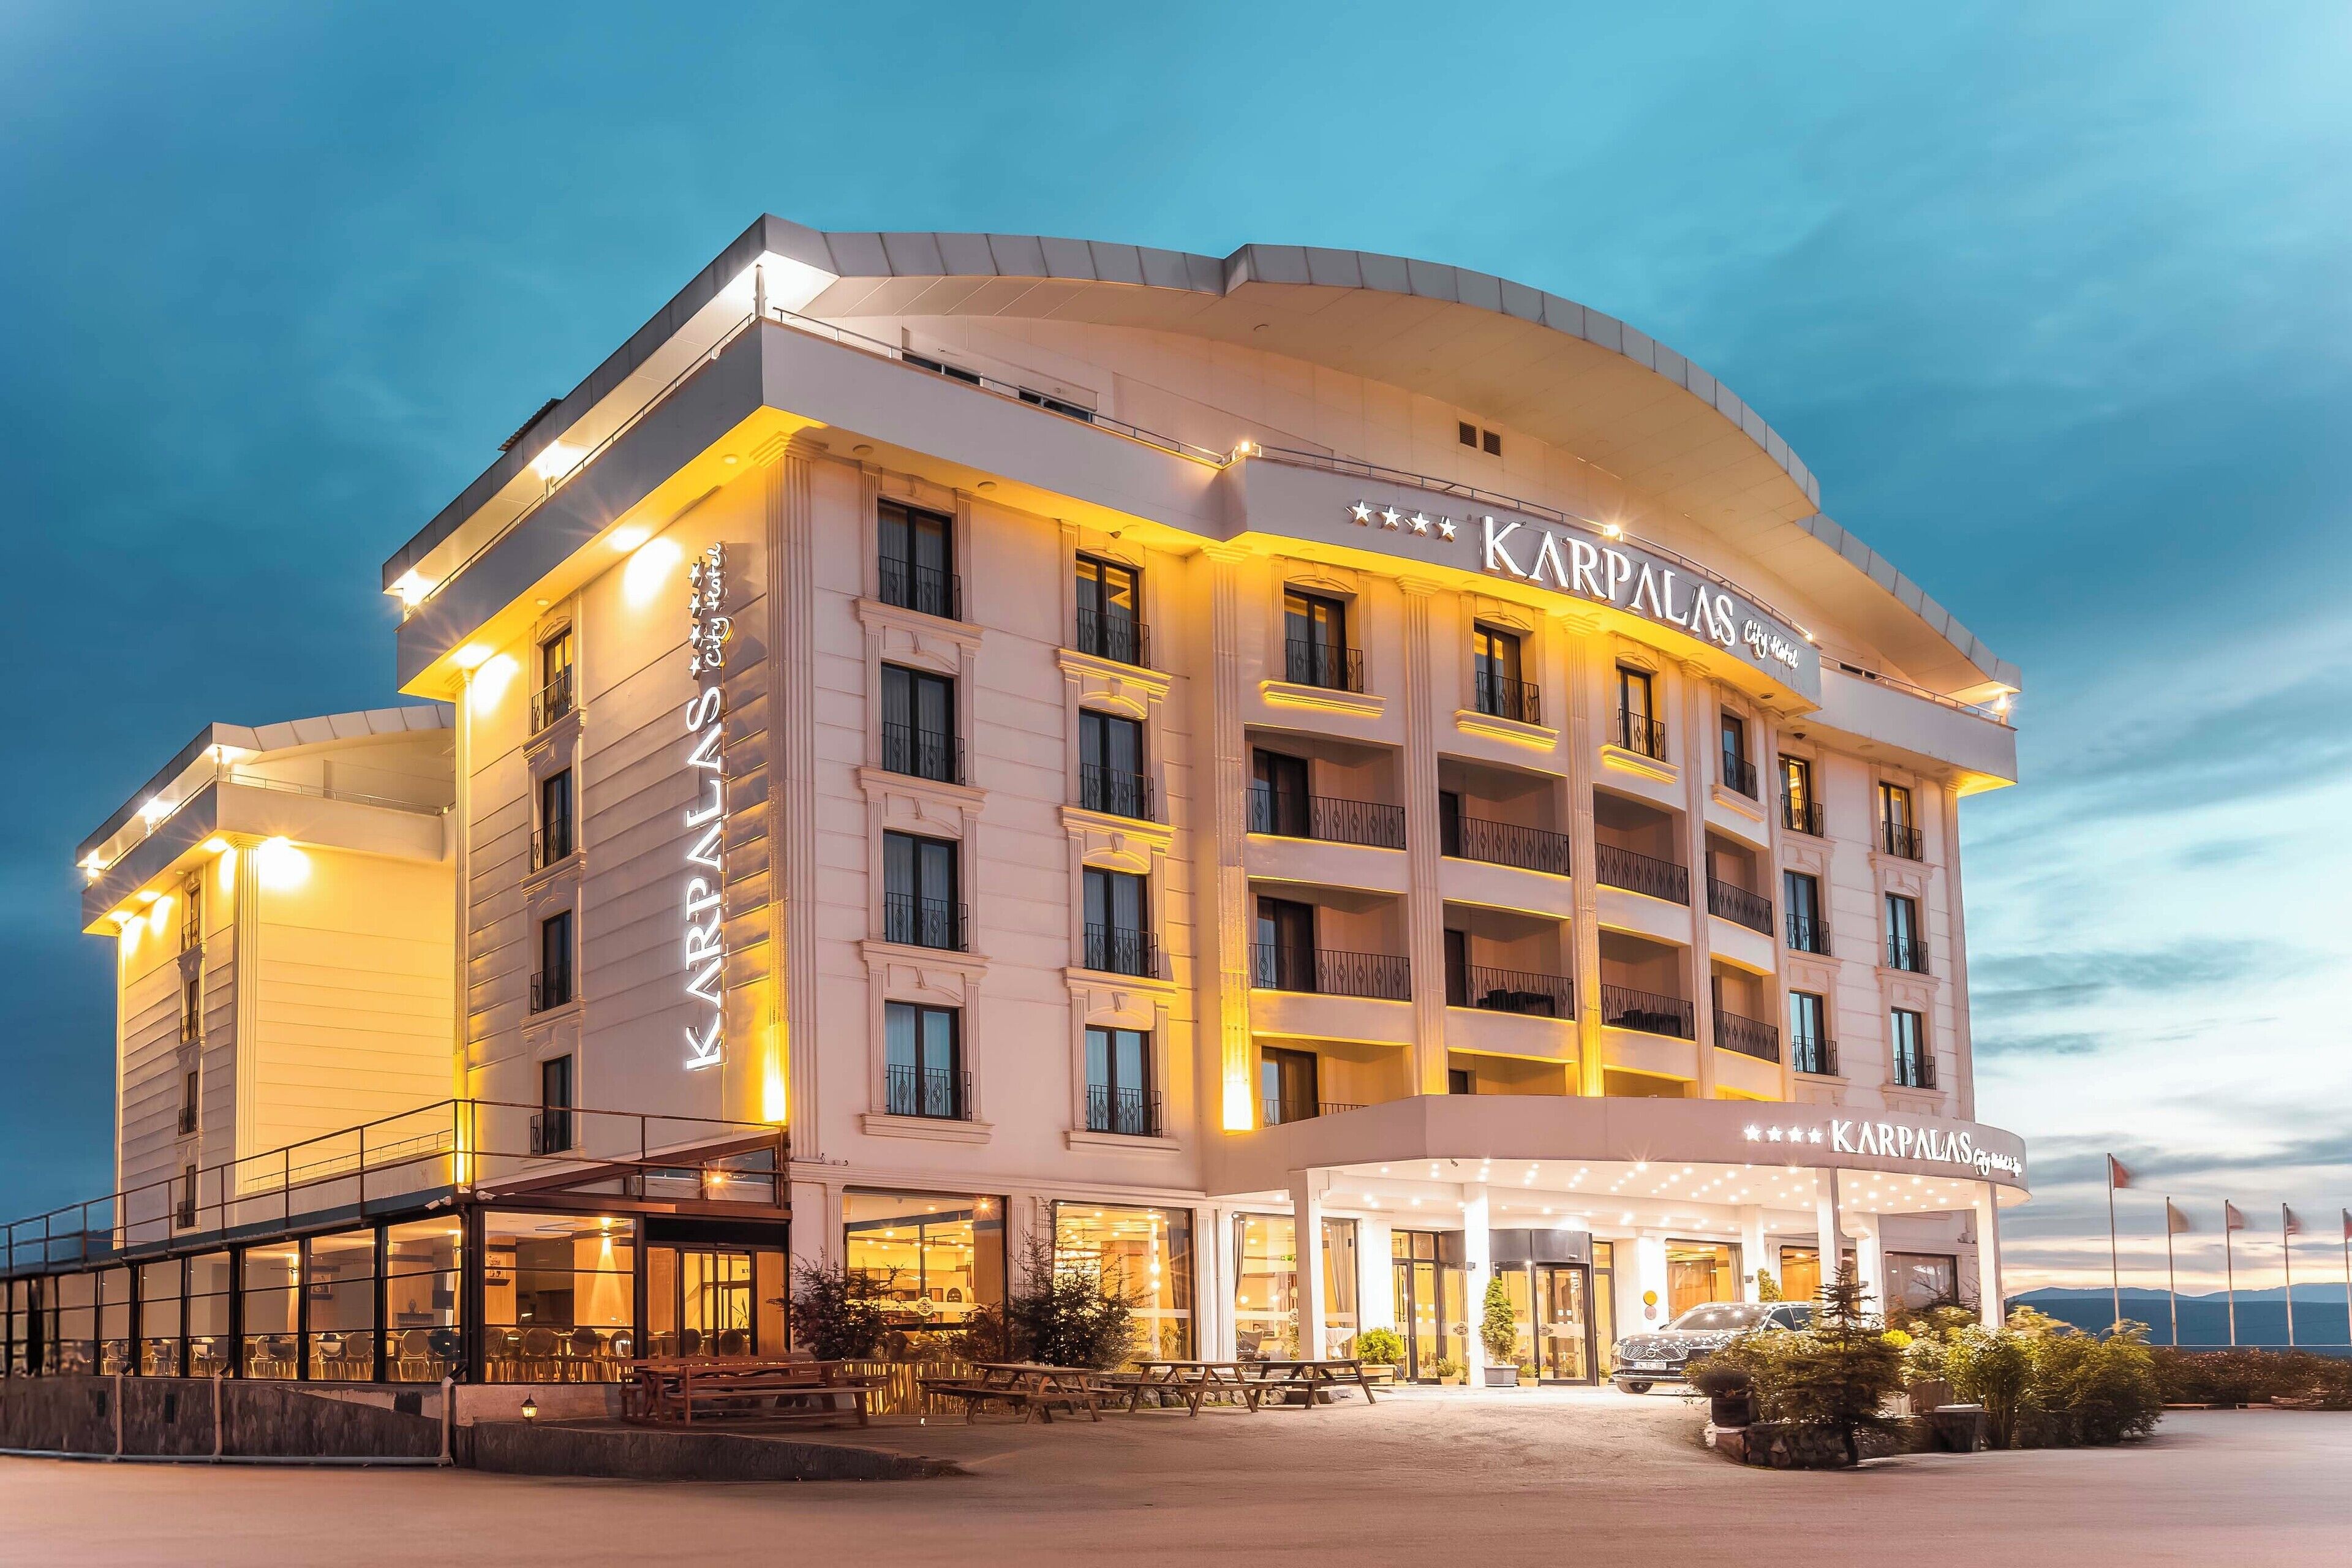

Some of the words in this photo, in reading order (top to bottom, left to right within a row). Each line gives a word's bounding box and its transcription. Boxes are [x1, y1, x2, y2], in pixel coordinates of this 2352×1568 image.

[706, 542, 722, 611] Hotel
[1480, 515, 1736, 647] KARPALAS
[1744, 619, 1768, 659] City
[705, 617, 729, 666] City
[685, 686, 722, 1071] KARPALAS
[1831, 1119, 1972, 1164] KARPALAS
